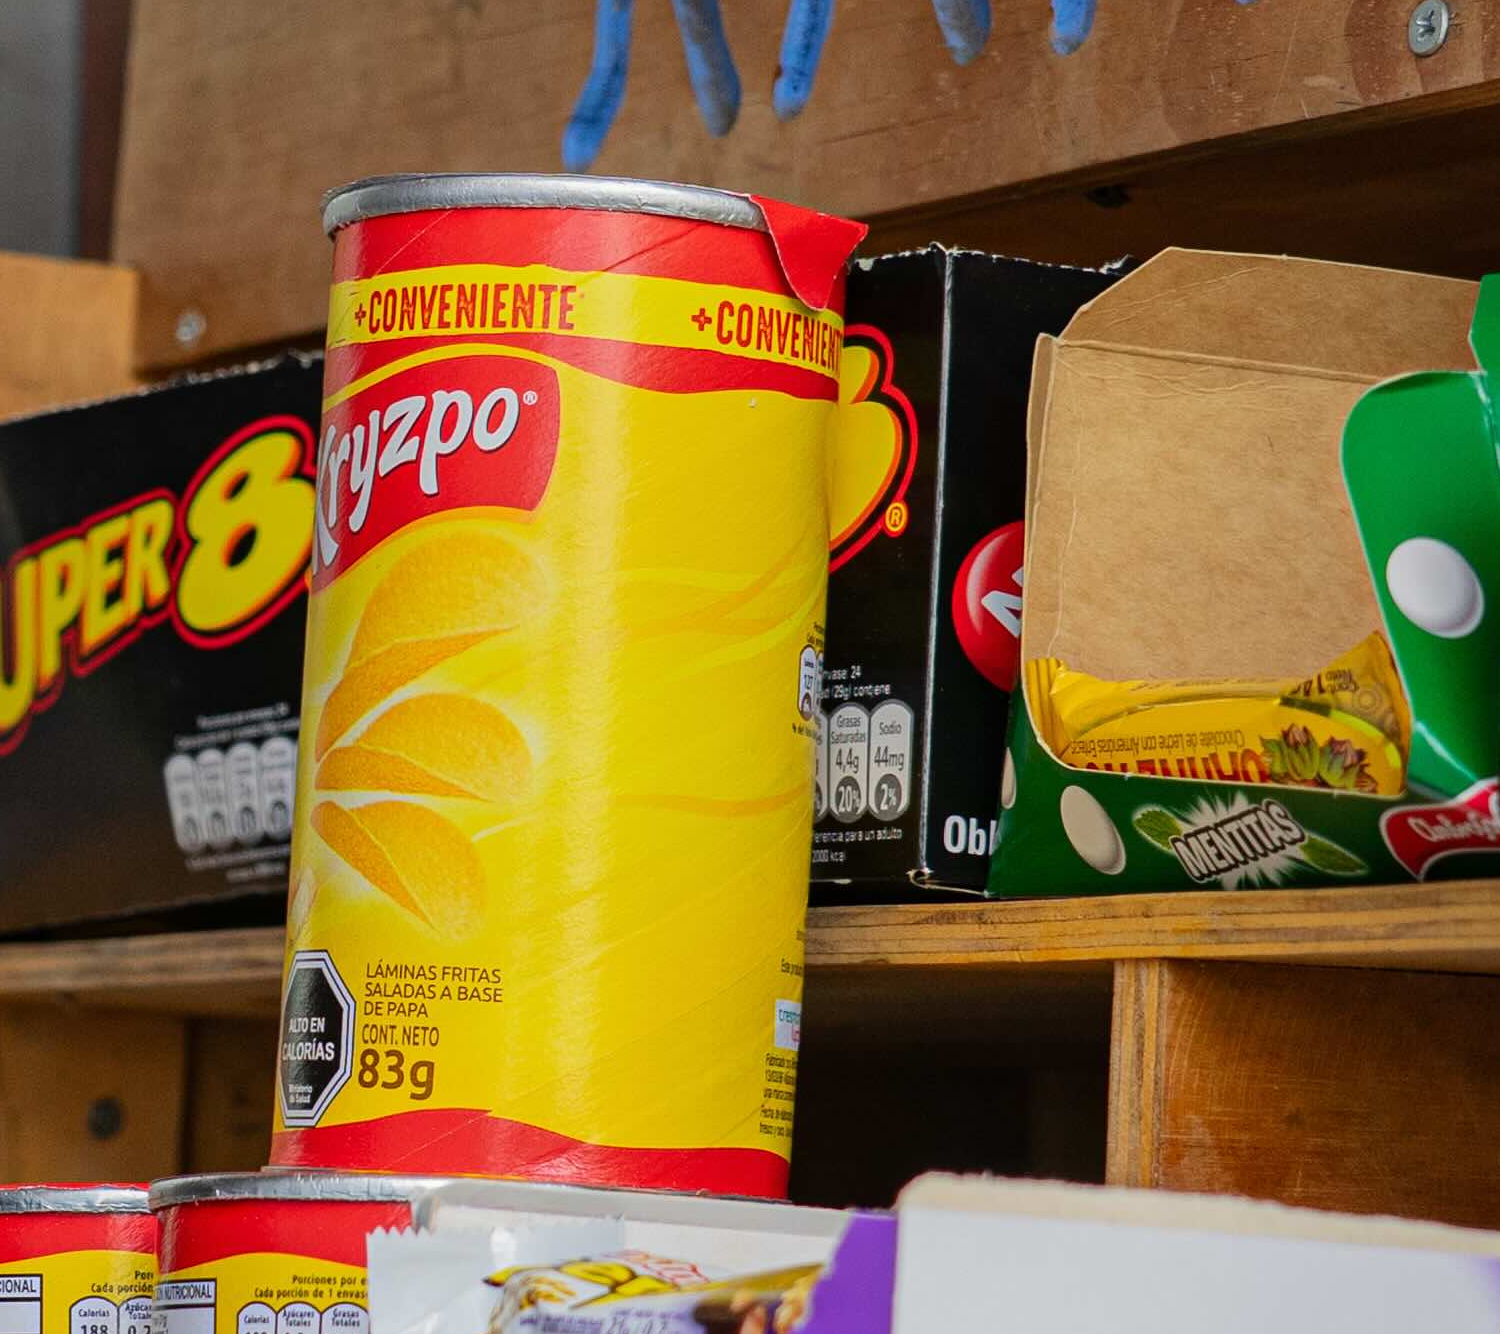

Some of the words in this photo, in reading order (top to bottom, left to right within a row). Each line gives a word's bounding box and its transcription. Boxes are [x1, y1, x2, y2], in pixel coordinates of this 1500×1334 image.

[175, 429, 318, 633] 8
[854, 683, 890, 697] contiene
[836, 715, 861, 727] Grasas
[879, 722, 902, 735] Sodio
[831, 730, 865, 744] Saturadas
[1159, 734, 1185, 753] Leche
[1199, 729, 1245, 749] Chocolate
[836, 749, 859, 774] 4,4g
[874, 746, 904, 771] 44mg
[838, 785, 861, 813] 20%
[881, 784, 896, 811] 2%
[844, 831, 863, 844] para
[876, 827, 902, 840] adulto
[1171, 800, 1306, 881] MENTITAS
[830, 850, 845, 862] kcal
[366, 959, 437, 981] LÁMINAS
[441, 966, 501, 984] FRITAS
[364, 982, 436, 1000] SALADAS
[440, 986, 451, 999] A
[458, 987, 503, 1002] BASE
[363, 1001, 383, 1016] DE
[387, 1002, 429, 1018] PAPA
[288, 1018, 309, 1032] ALTO
[311, 1018, 325, 1032] EN
[361, 1024, 397, 1046] CONT.
[402, 1025, 440, 1047] NETO
[282, 1038, 335, 1061] CALORÍAS
[357, 1049, 436, 1101] 83g
[91, 1283, 113, 1293] Cada
[293, 1275, 337, 1286] Porciones
[341, 1277, 357, 1288] por
[255, 1288, 273, 1298] Cada
[276, 1288, 309, 1300] porción
[312, 1288, 324, 1298] de
[79, 1308, 109, 1318] Calorías
